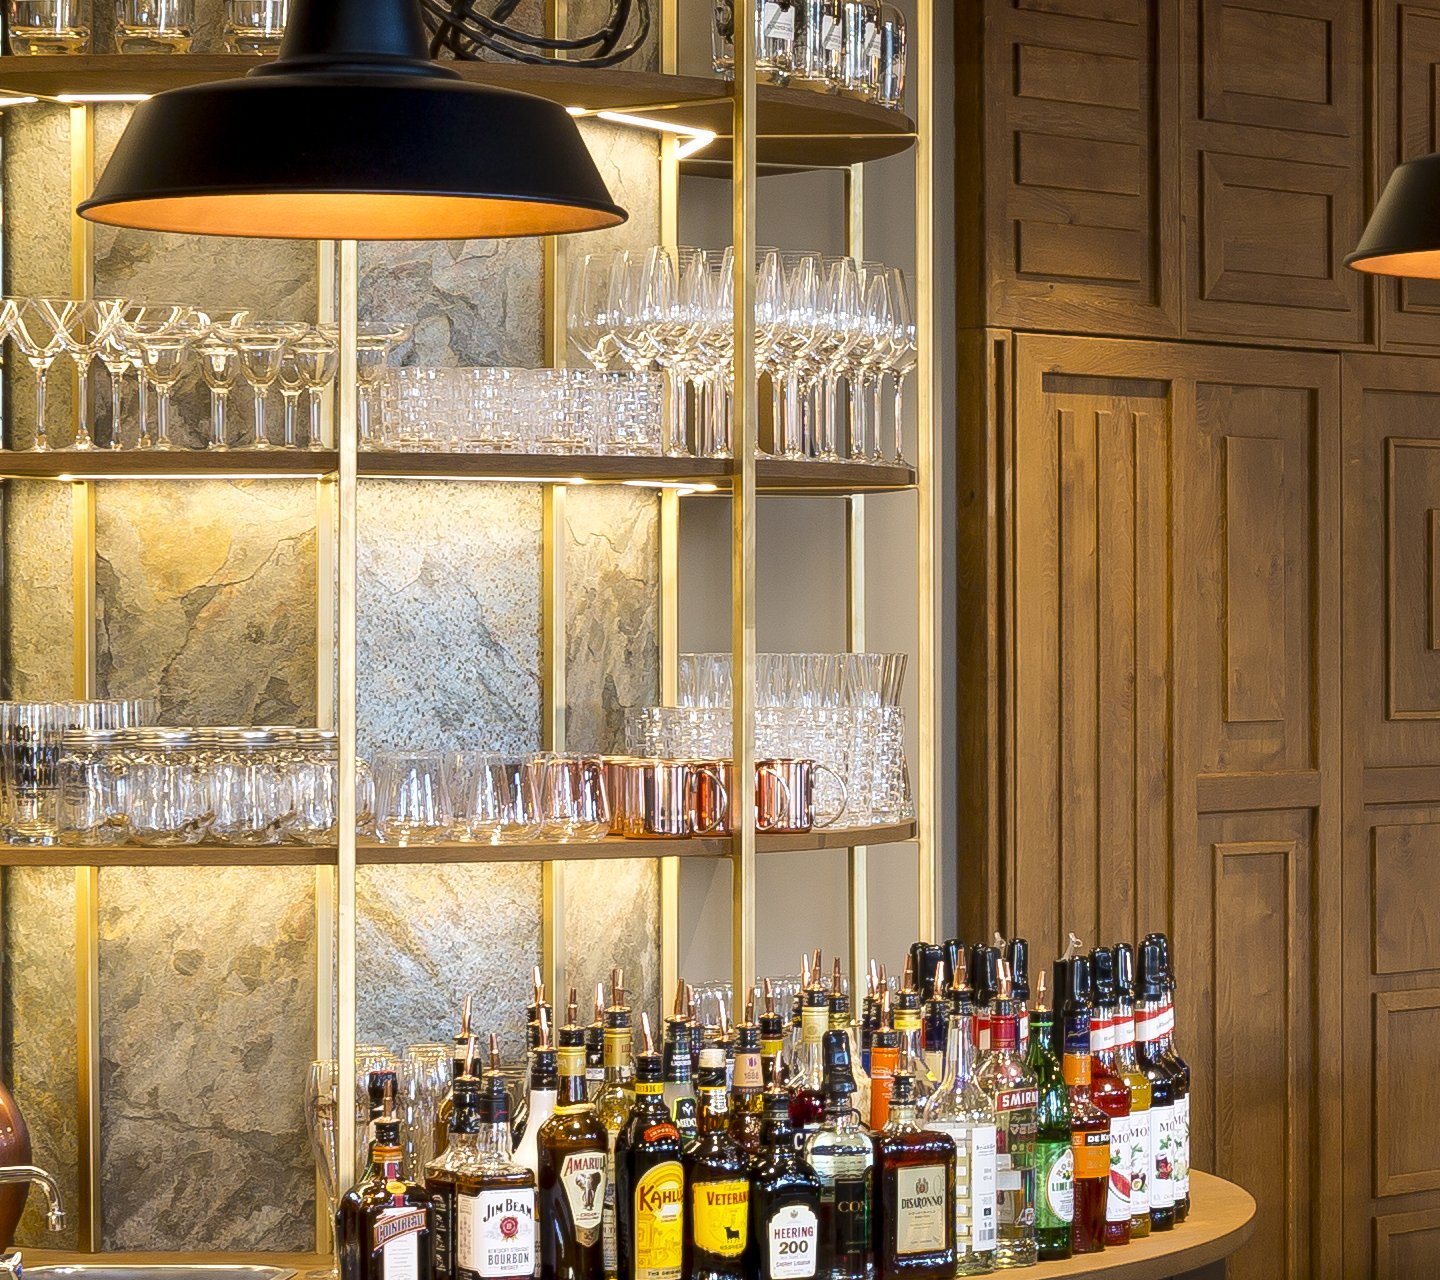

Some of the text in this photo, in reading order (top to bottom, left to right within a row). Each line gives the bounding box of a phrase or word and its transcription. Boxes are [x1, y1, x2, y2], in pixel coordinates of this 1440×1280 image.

[1051, 1182, 1068, 1192] LIME
[901, 1195, 943, 1210] DISARONNO
[483, 1198, 532, 1223] JIM BEAM
[376, 1213, 426, 1244] COINTREAU
[774, 1226, 814, 1239] HEERING
[779, 1239, 809, 1255] 200
[488, 1252, 530, 1265] BOURBON
